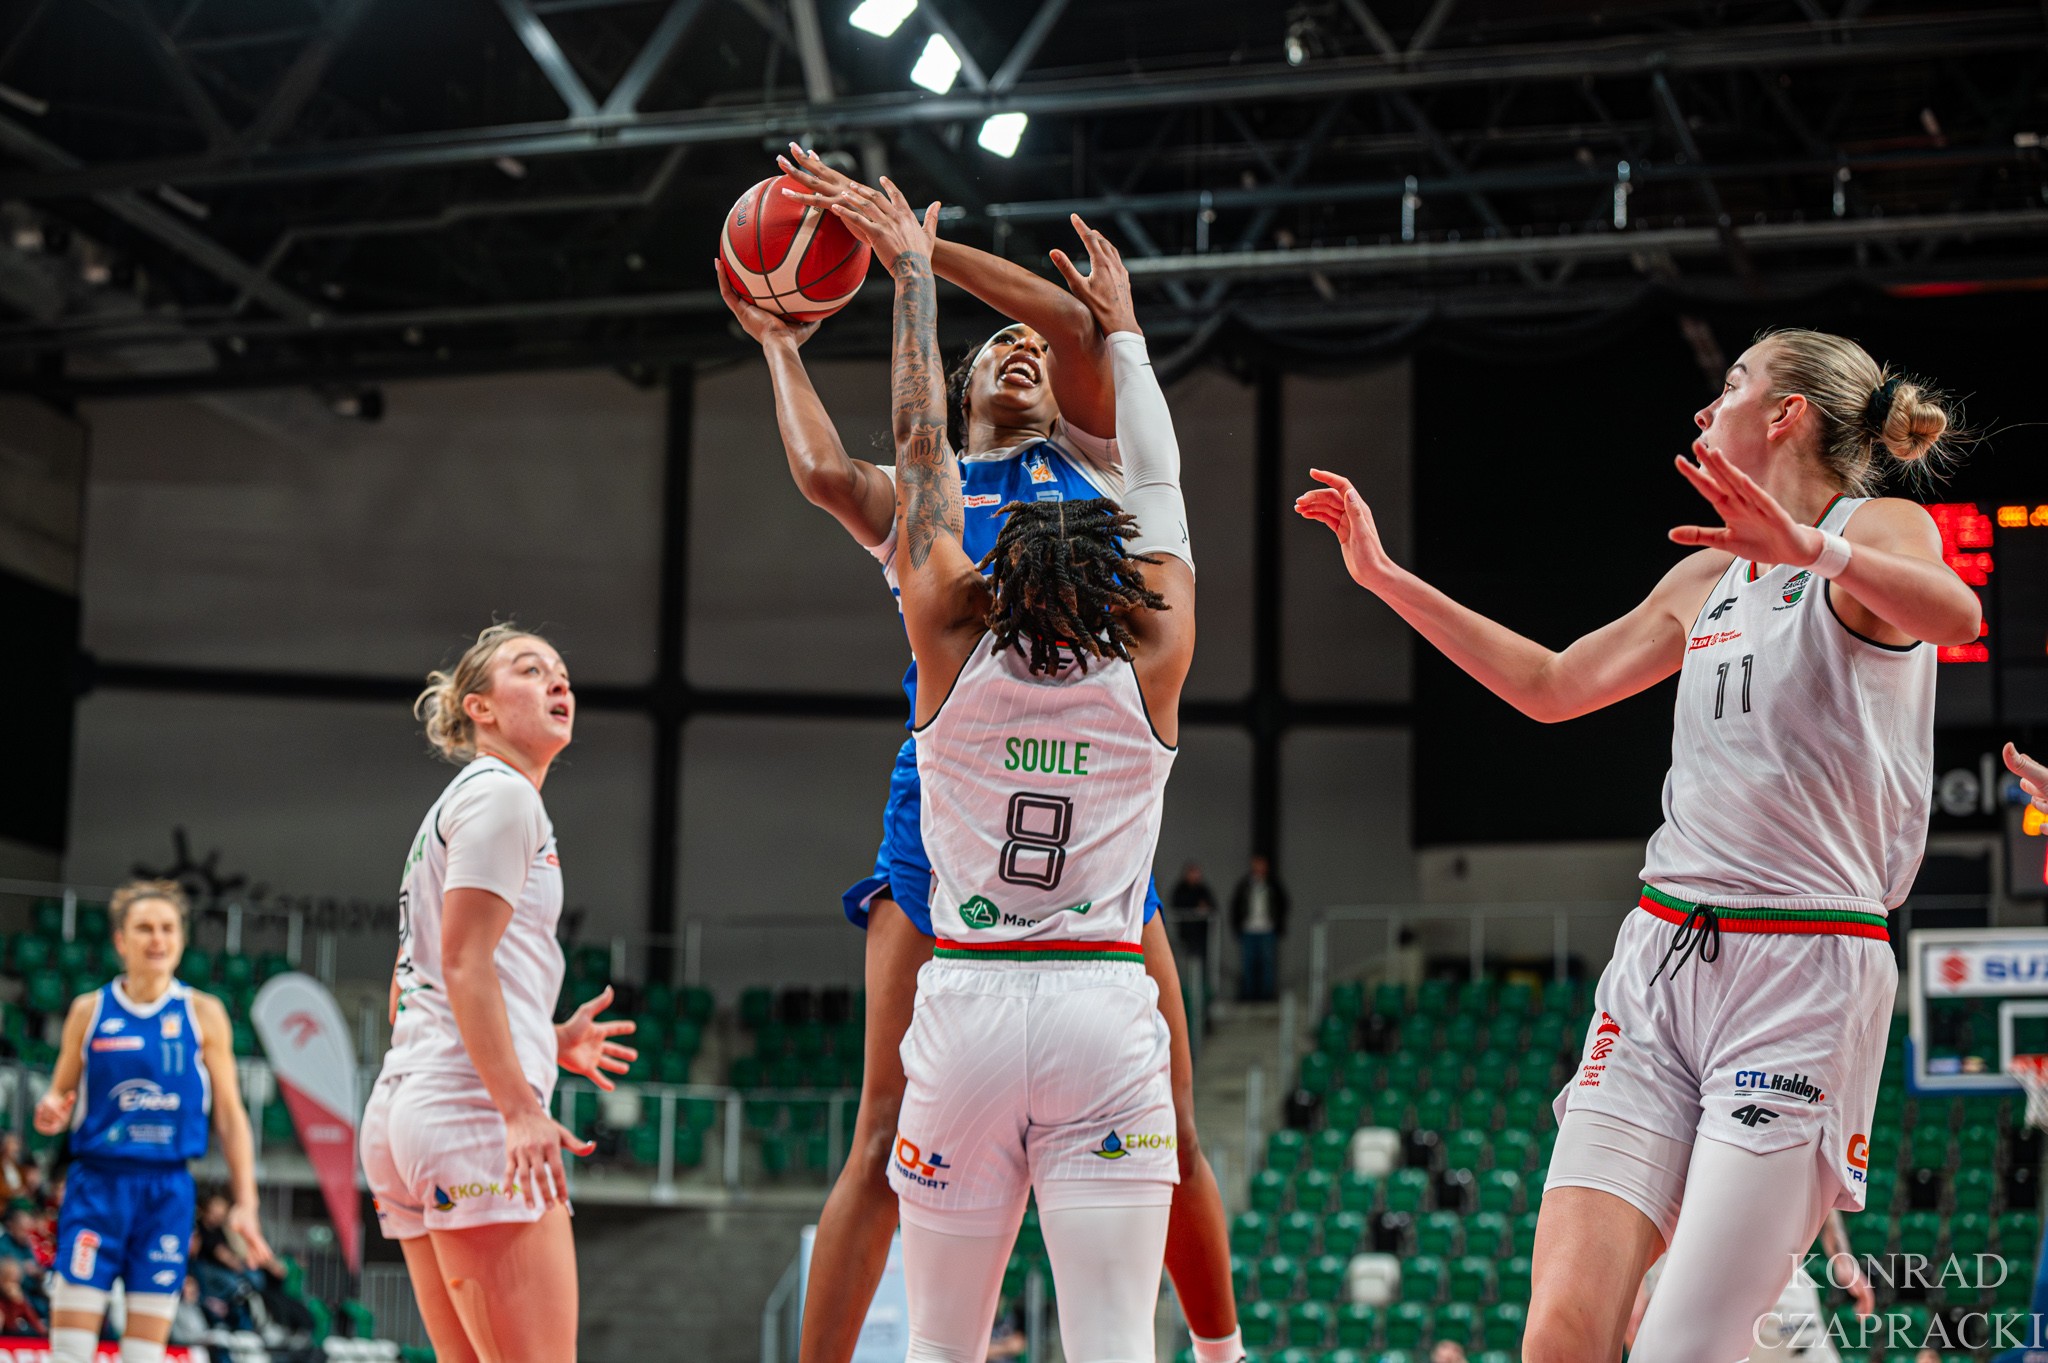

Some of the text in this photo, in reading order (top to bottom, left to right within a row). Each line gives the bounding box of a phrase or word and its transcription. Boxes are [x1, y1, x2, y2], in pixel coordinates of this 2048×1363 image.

[1708, 597, 1738, 620] 4F
[1714, 654, 1754, 720] 11
[1004, 736, 1090, 775] SOULE
[999, 791, 1074, 891] 8
[1984, 954, 2048, 981] SU
[1731, 1104, 1780, 1128] 4F
